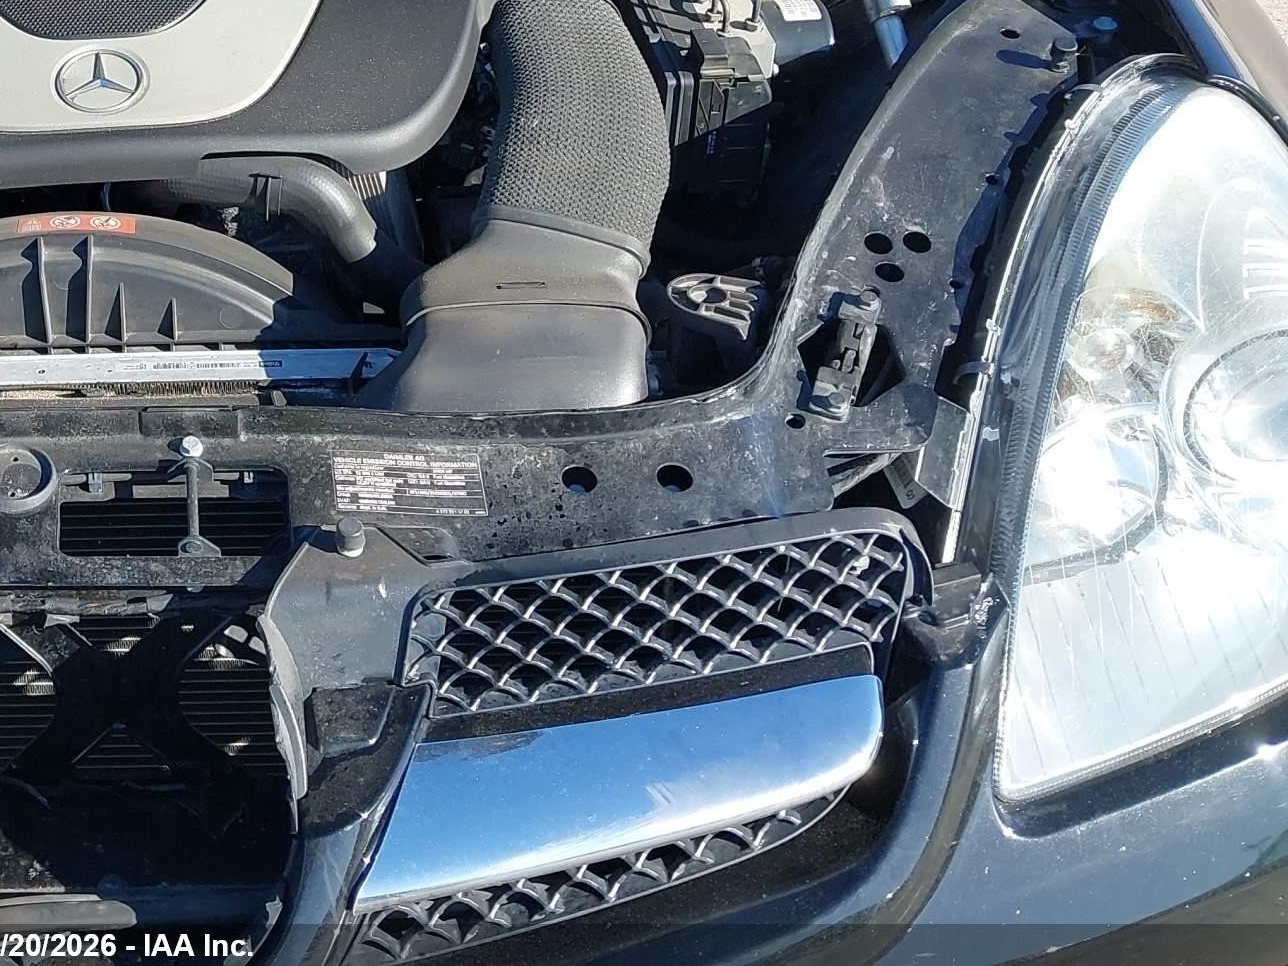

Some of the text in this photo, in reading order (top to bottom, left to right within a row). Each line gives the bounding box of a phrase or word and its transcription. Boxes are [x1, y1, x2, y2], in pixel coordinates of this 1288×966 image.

[333, 457, 362, 465] VEHICLE
[363, 458, 396, 466] EMISSION
[397, 459, 428, 467] CONTROL
